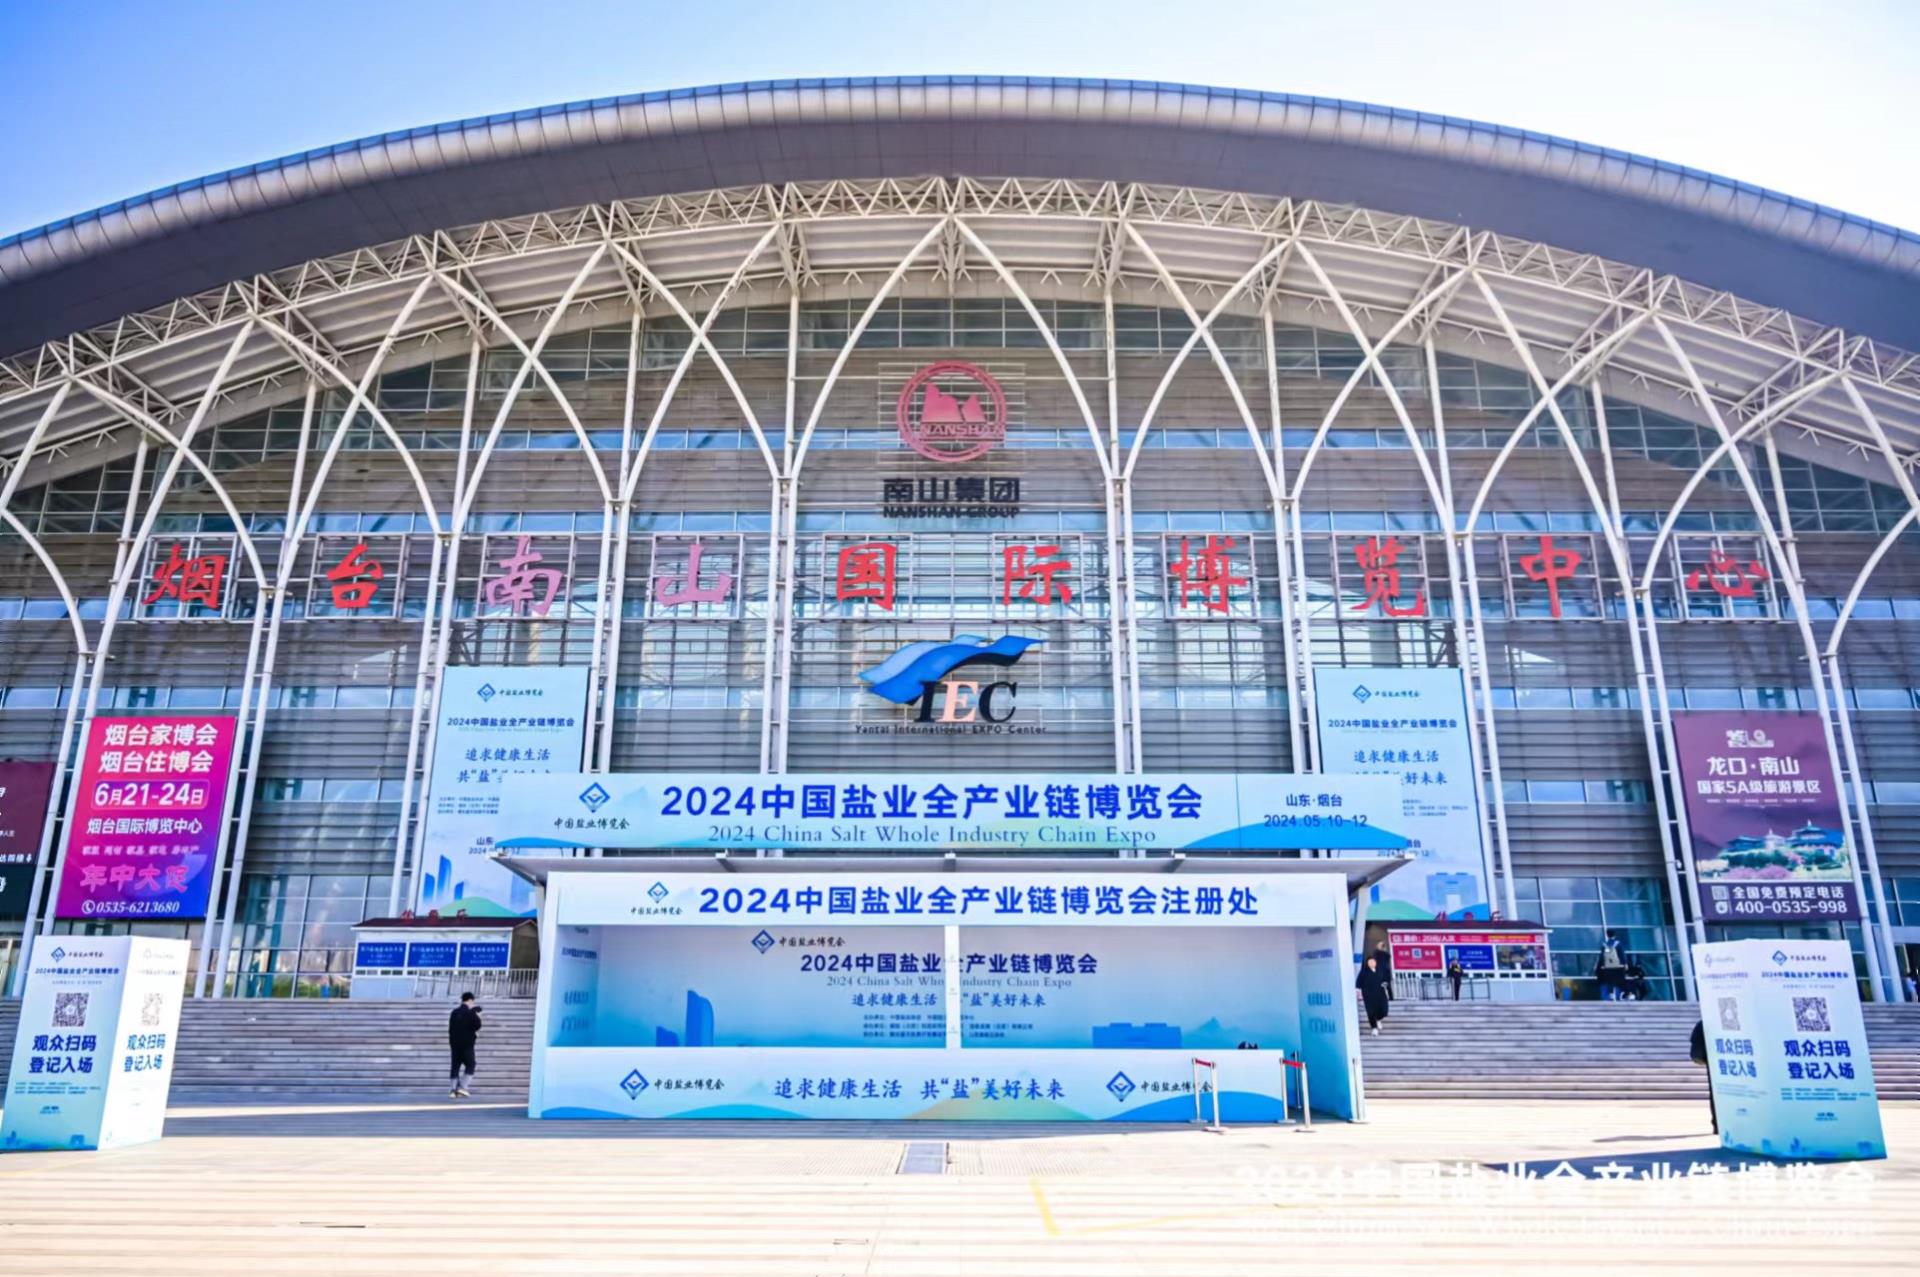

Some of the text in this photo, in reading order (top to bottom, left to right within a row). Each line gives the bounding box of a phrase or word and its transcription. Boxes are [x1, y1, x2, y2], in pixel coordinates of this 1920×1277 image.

[883, 477, 1020, 502] 南山集团
[883, 505, 1020, 518] NANSHAN GROUP
[141, 534, 1769, 618] 烟台南山国际博览中心
[447, 717, 575, 727] 2024中国盐业全产业链博览会
[855, 725, 1047, 735] Yantai International EXPO Center
[1328, 718, 1458, 728] 2024中国盐业全产业链博览会
[103, 723, 218, 745] 烟台家博会
[98, 750, 214, 773] 烟台住博会
[465, 748, 551, 761] 追求健康生活
[1354, 749, 1439, 763] 追求健康生活
[1706, 756, 1800, 776] 龙口·南山
[94, 783, 205, 806] 6月21-24日
[1697, 780, 1821, 794] 国家5A级旅游景区
[661, 783, 1202, 820] 2024中国盐业全产业链博览会
[1286, 794, 1343, 807] 山东·烟台
[86, 818, 203, 835] 烟台国际博览中心
[554, 817, 630, 831] 中国盐业博览会
[1264, 815, 1368, 828] 2024.05.10-12
[708, 825, 1157, 847] 2024 China Salt Whole Industry Chain Expo
[80, 864, 190, 893] 年中大促
[699, 885, 1259, 915] 2024中国盐业全产业链博览会注册处
[1732, 886, 1844, 899] 全国免费预定电话
[96, 901, 180, 913] 0535-6213680
[630, 905, 683, 916] 中国盐业博览会
[1735, 901, 1848, 914] 400-0535-998
[779, 936, 845, 948] 中国盐业博览会
[800, 953, 1098, 974] 2024中国盐业产业链博览会
[826, 976, 853, 987] 2024
[857, 976, 890, 987] China
[894, 976, 913, 987] Salt
[960, 976, 1001, 989] ndustry
[1006, 976, 1040, 988] Chain
[1044, 976, 1072, 990] Expo
[852, 992, 937, 1007] 追求健康生活
[32, 1034, 97, 1052] 观众扫码
[126, 1033, 166, 1052] 观众扫码
[1715, 1038, 1754, 1056] 观众扫码
[1783, 1039, 1851, 1058] 观众扫码
[28, 1056, 93, 1074] 登记入场
[124, 1054, 163, 1073] 登记入场
[1718, 1059, 1757, 1078] 登记入场
[1787, 1062, 1855, 1080] 登记入场
[654, 1077, 725, 1091] 中国盐业博览会
[774, 1077, 1065, 1100] 追求健康生活 共“盐”美好未来
